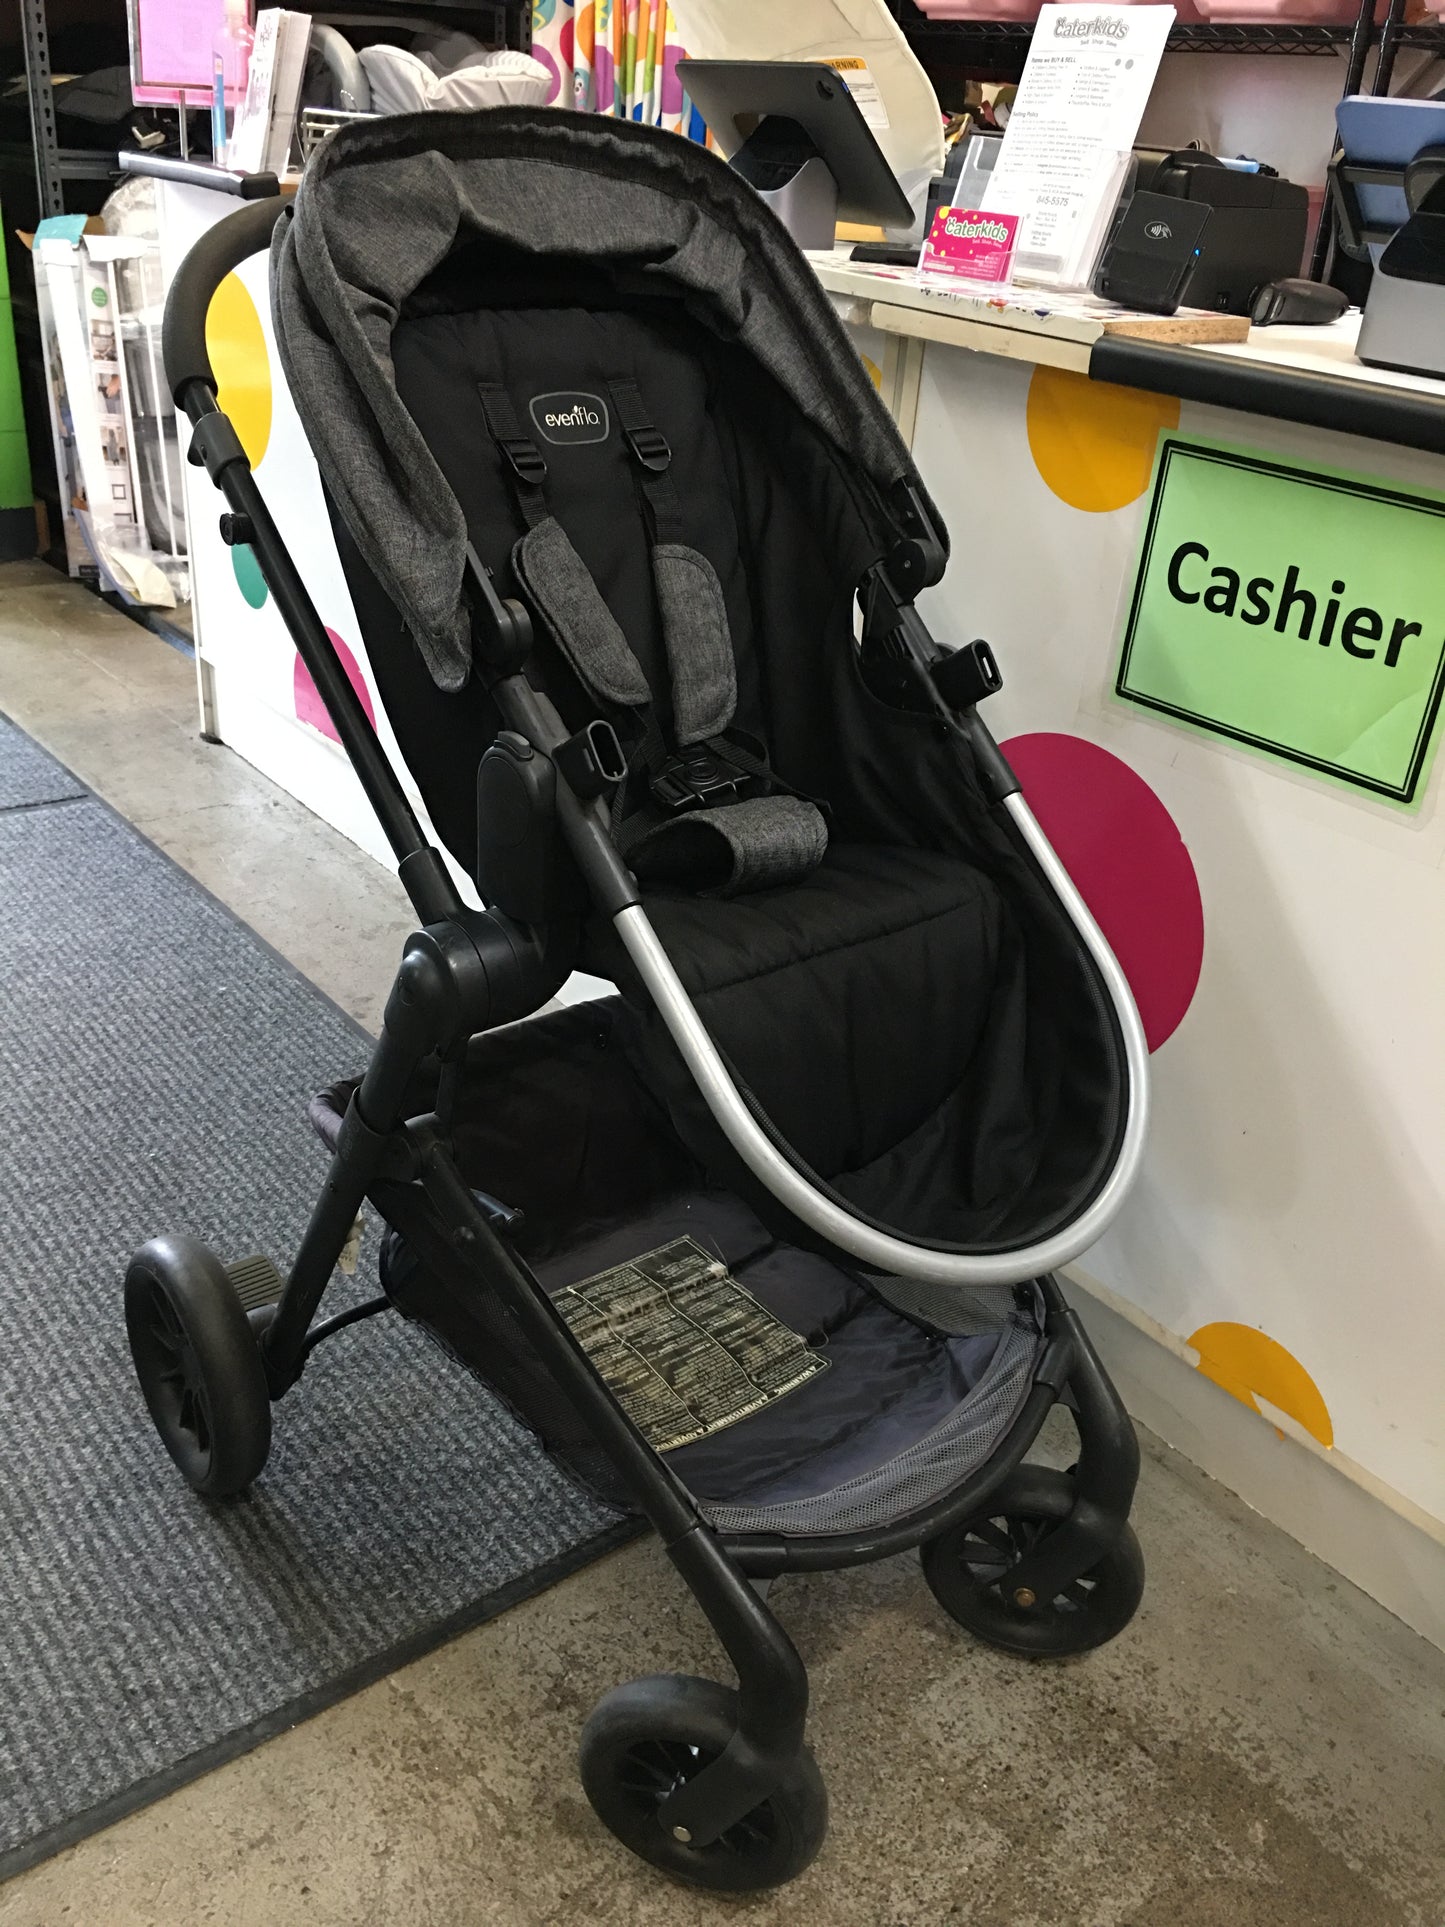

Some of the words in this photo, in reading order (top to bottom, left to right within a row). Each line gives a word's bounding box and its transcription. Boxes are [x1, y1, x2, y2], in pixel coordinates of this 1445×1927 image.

[1053, 15, 1129, 40] Caterkids
[831, 60, 859, 70] ARNING
[945, 216, 1008, 242] Caterkids
[545, 405, 600, 427] evenflo
[1168, 541, 1422, 668] Cashier
[774, 1370, 812, 1395] WARNING
